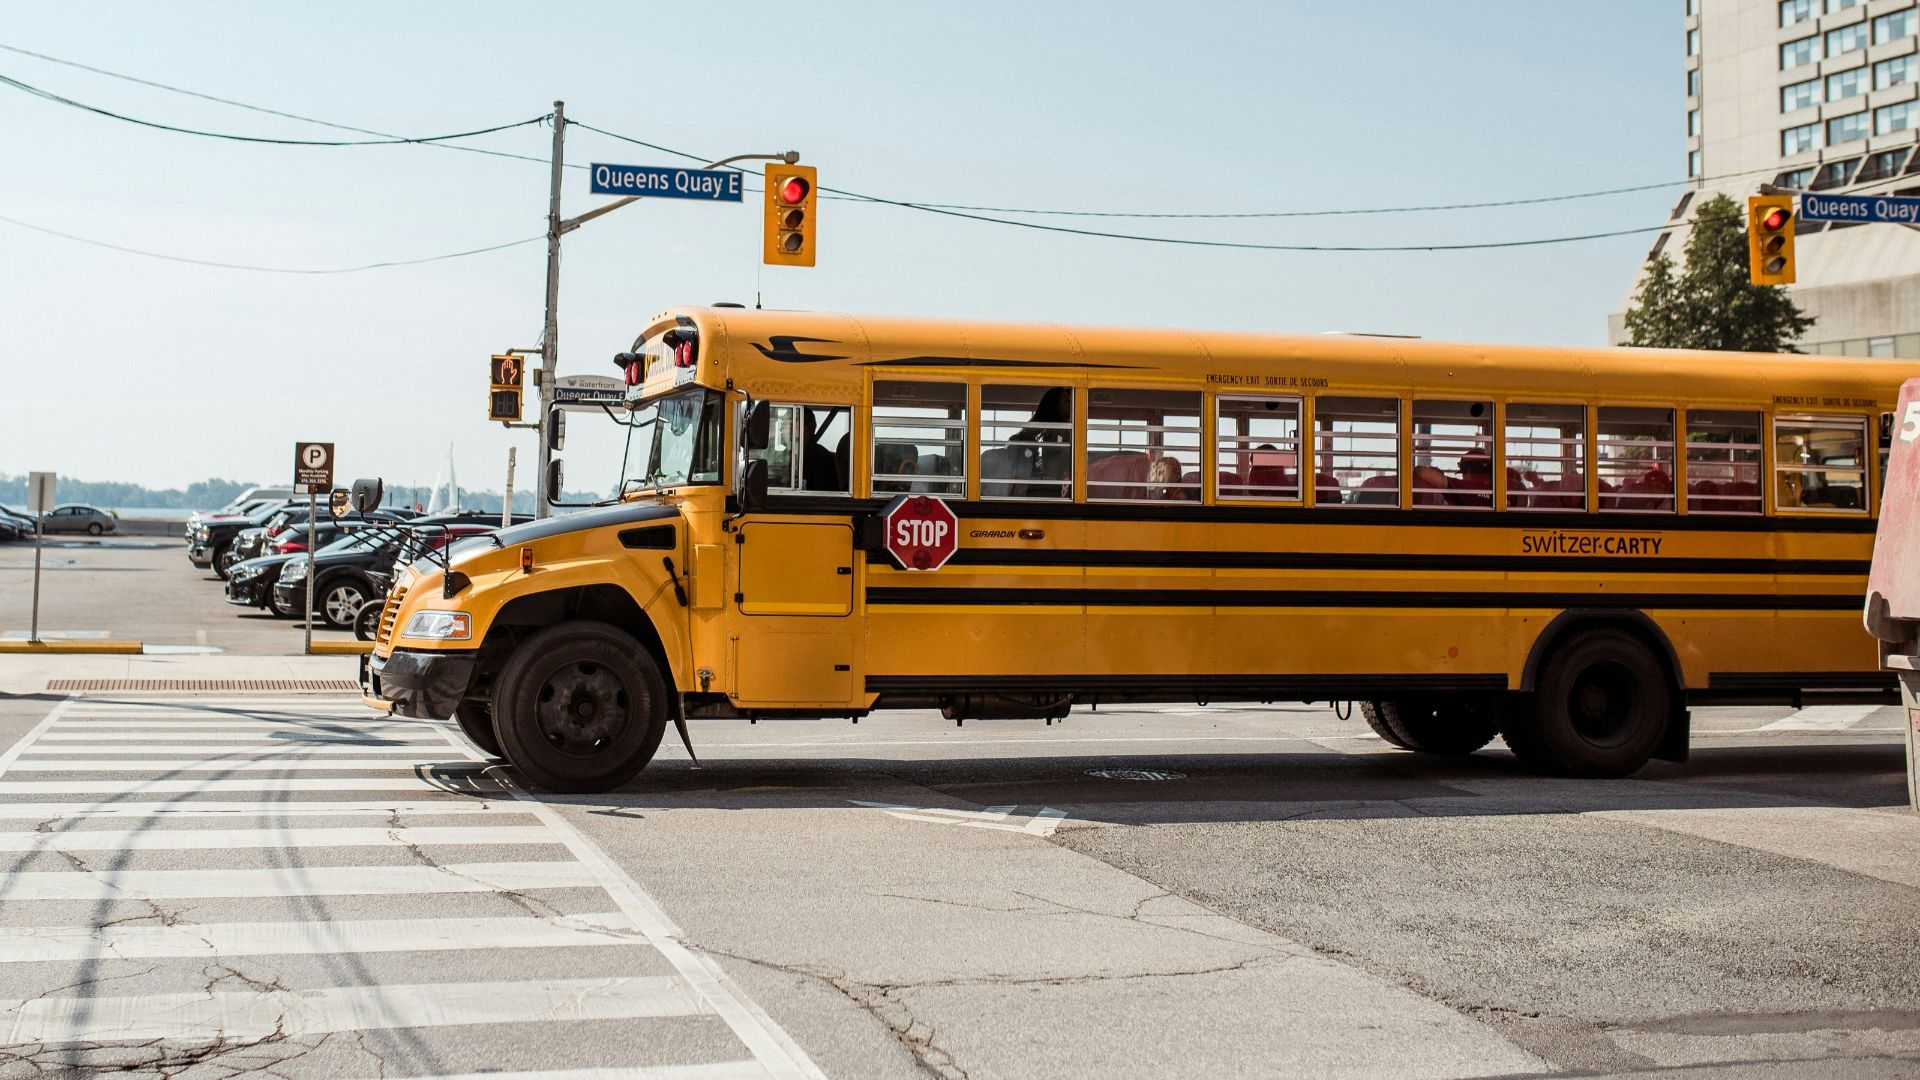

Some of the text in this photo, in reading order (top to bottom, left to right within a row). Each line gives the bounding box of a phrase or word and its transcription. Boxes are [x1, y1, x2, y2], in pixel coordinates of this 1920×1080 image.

[596, 166, 740, 198] Queens Quay E
[1806, 196, 1919, 222] Queens Quay
[578, 381, 616, 389] waterfront
[1206, 374, 1329, 388] EMERGENCY EXIT SORTIE DE SECOURS
[556, 389, 591, 400] Queens
[310, 449, 322, 464] P
[897, 519, 949, 548] STOP
[969, 530, 1017, 539] GIRARDIN
